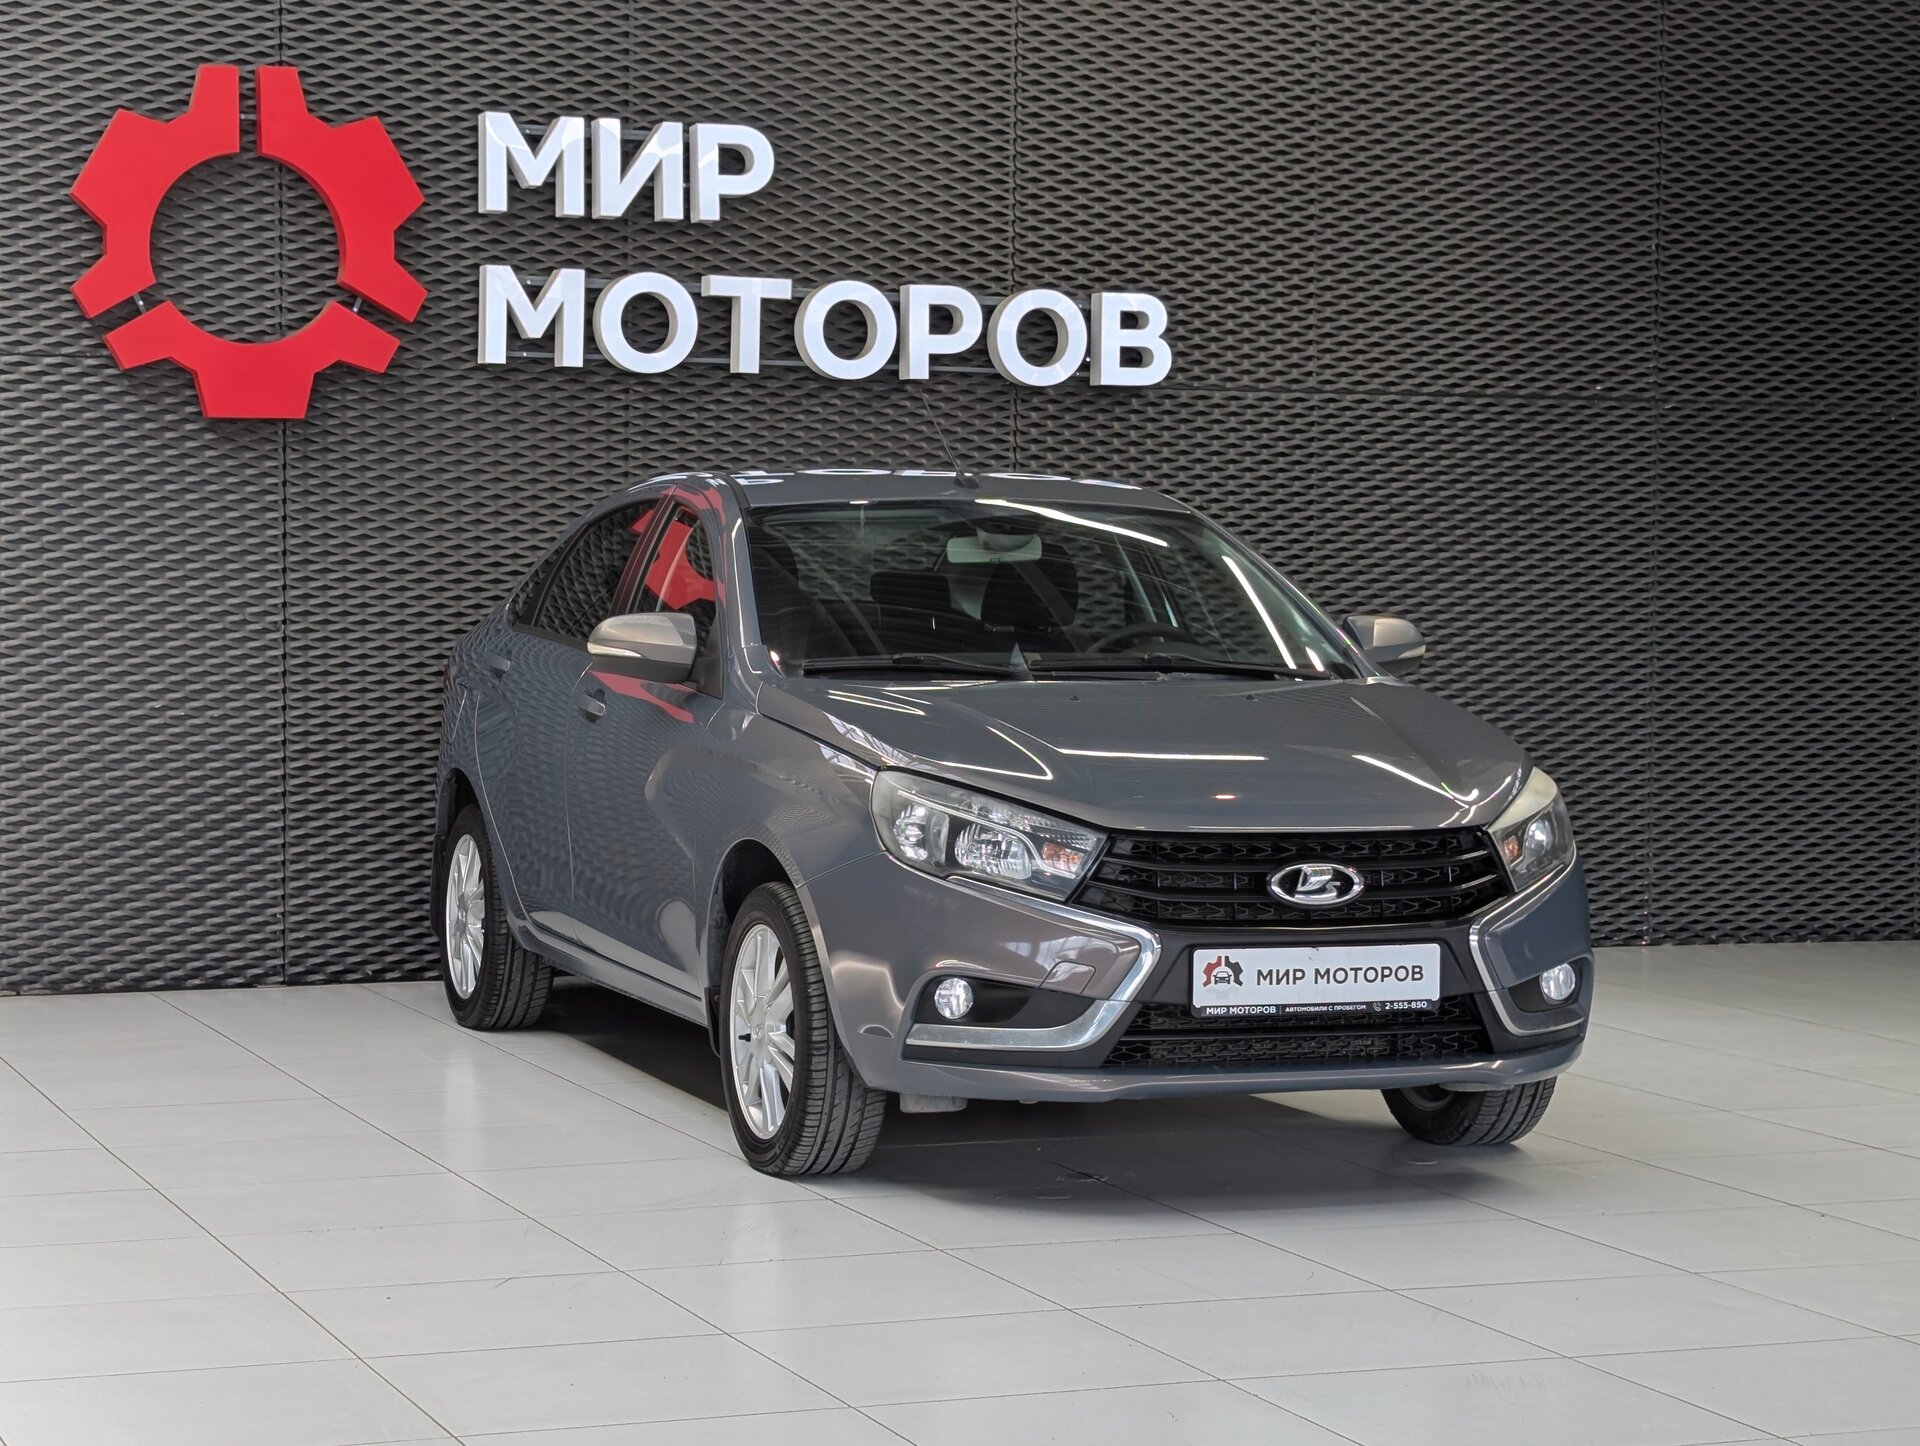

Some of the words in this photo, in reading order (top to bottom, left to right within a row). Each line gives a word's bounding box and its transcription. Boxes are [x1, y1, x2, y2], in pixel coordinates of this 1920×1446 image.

[477, 111, 776, 223] МИР
[477, 264, 1174, 388] МОТОРОВ
[1206, 1007, 1227, 1015] МИР
[1229, 1006, 1277, 1014] МОТОРОВ
[1385, 1001, 1427, 1010] 2-555-850
[1256, 968, 1306, 986] МИР
[1314, 965, 1424, 985] МОТОРОВ
